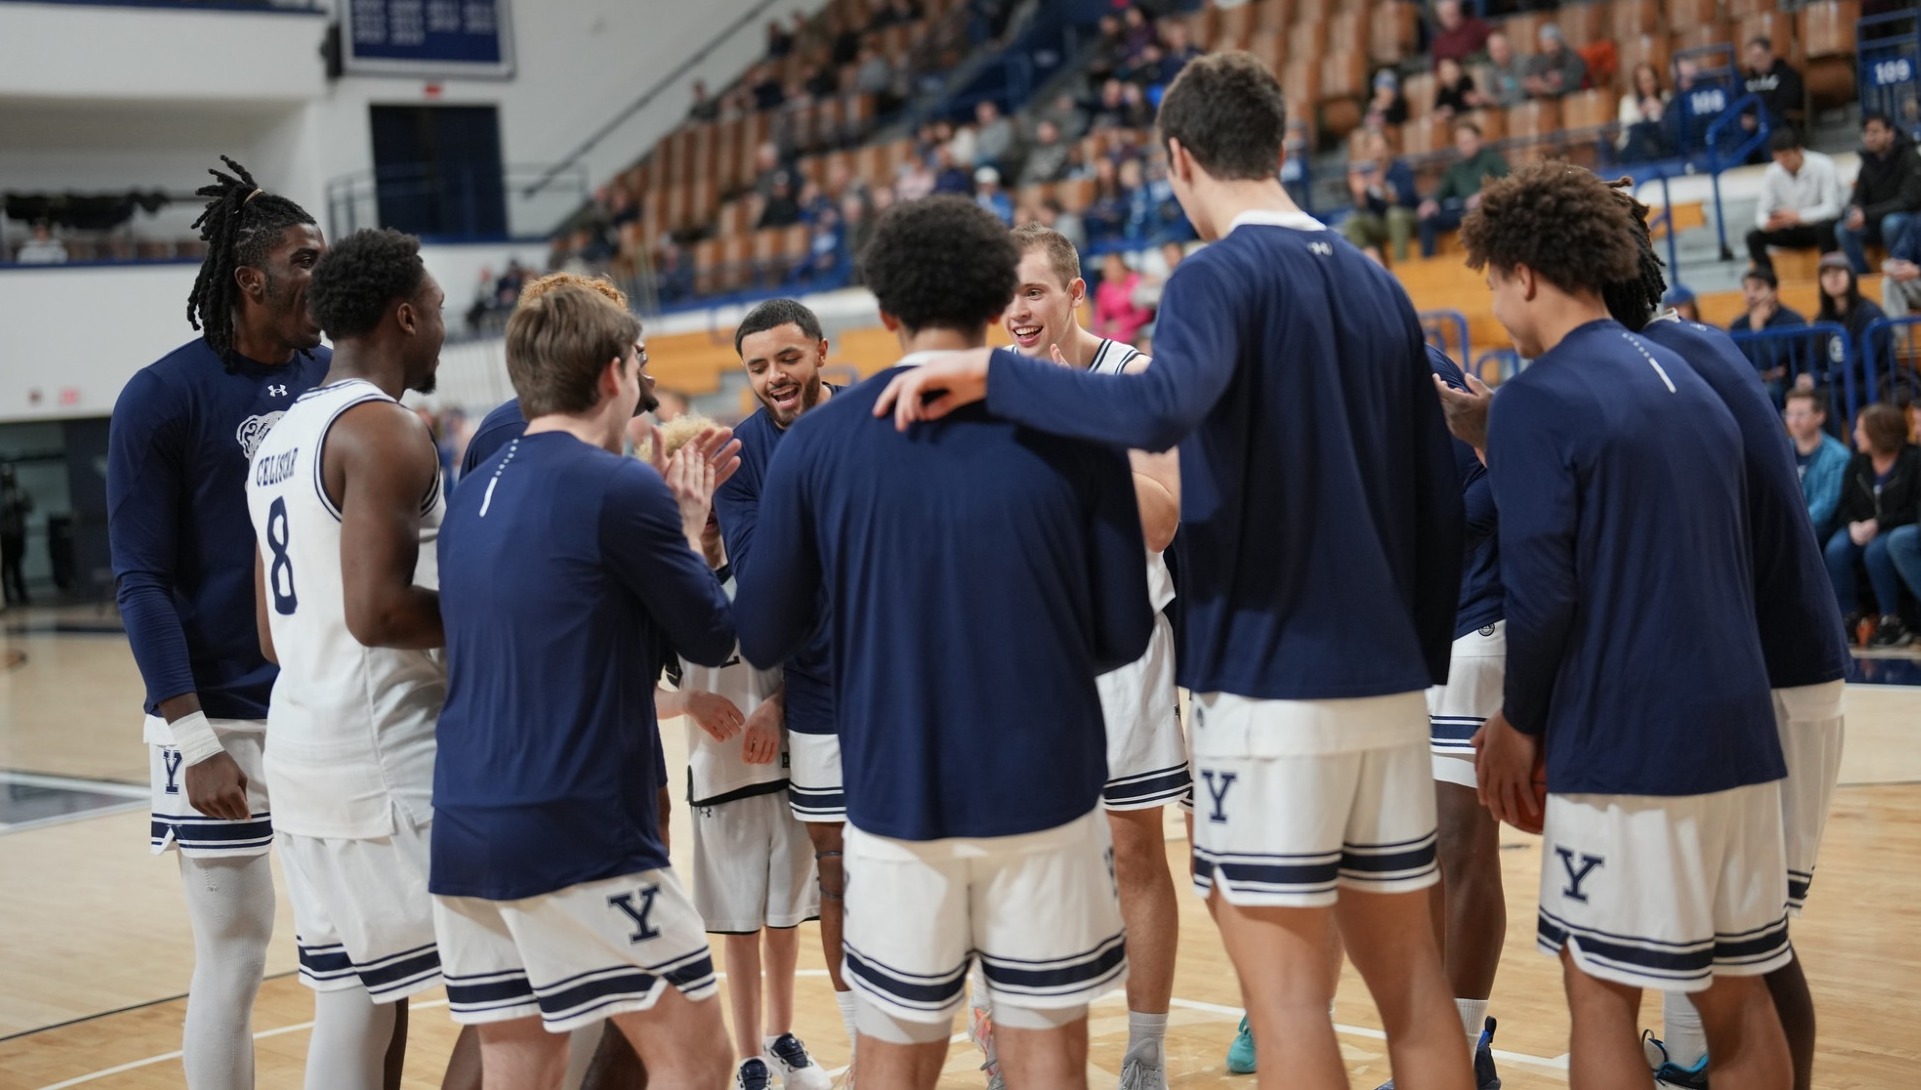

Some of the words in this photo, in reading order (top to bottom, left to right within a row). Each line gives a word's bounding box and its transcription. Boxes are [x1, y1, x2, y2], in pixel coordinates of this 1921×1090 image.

[267, 496, 298, 615] 8
[163, 748, 183, 796] Y
[1201, 769, 1238, 824] Y
[1554, 844, 1605, 905] Y
[606, 881, 662, 946] Y
